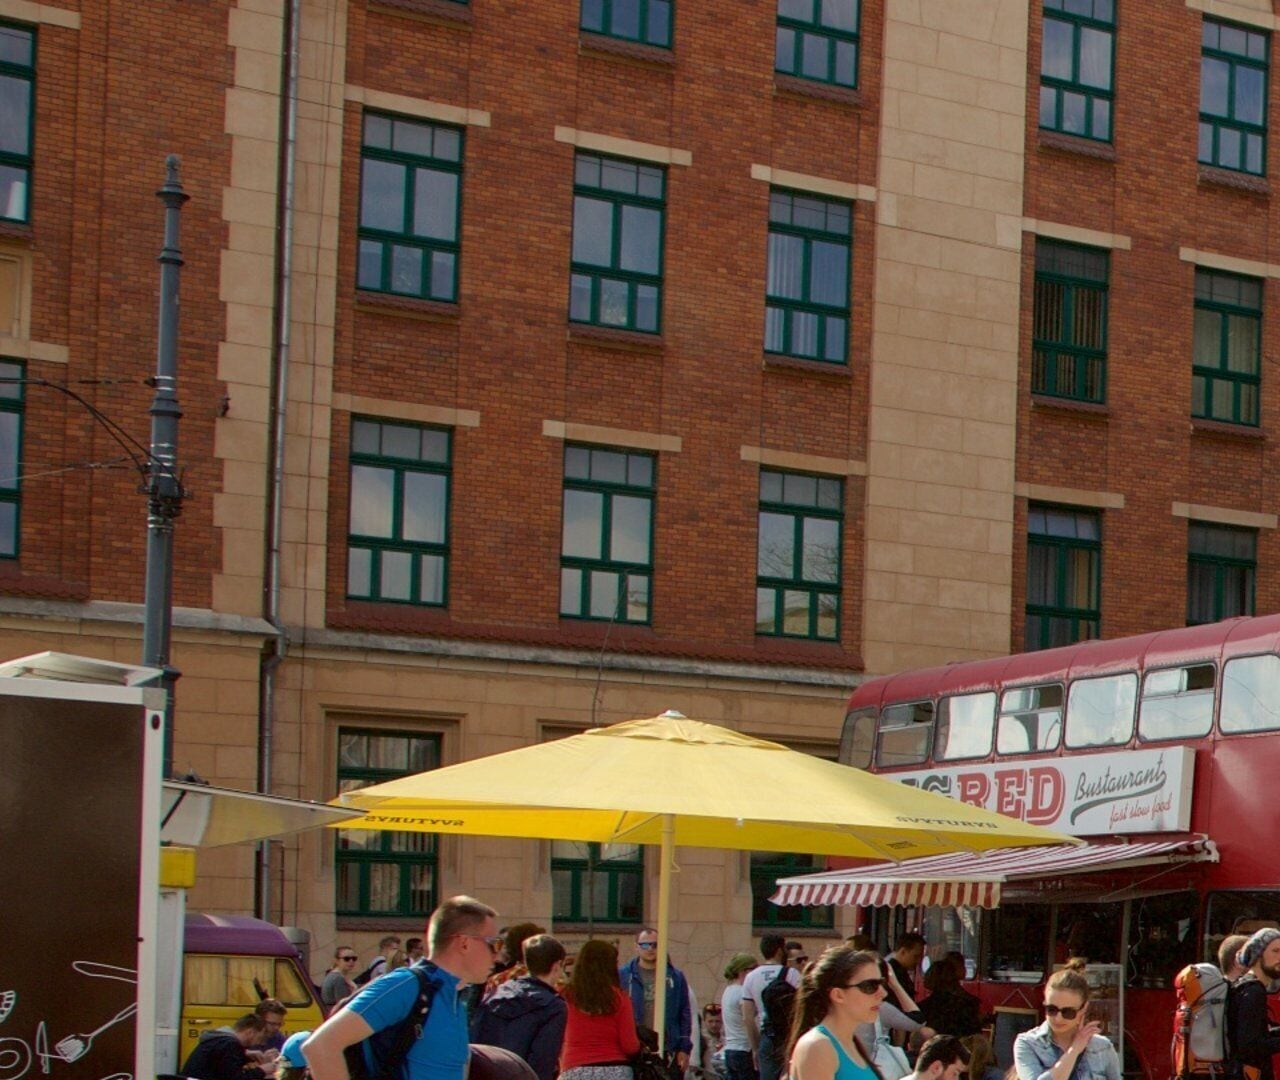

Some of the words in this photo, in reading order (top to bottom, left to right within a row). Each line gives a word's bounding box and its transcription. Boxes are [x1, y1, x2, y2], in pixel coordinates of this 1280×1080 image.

[1074, 753, 1167, 801] Bustaurant
[1109, 803, 1128, 829] fast
[1129, 797, 1150, 821] slow
[1151, 793, 1173, 821] food
